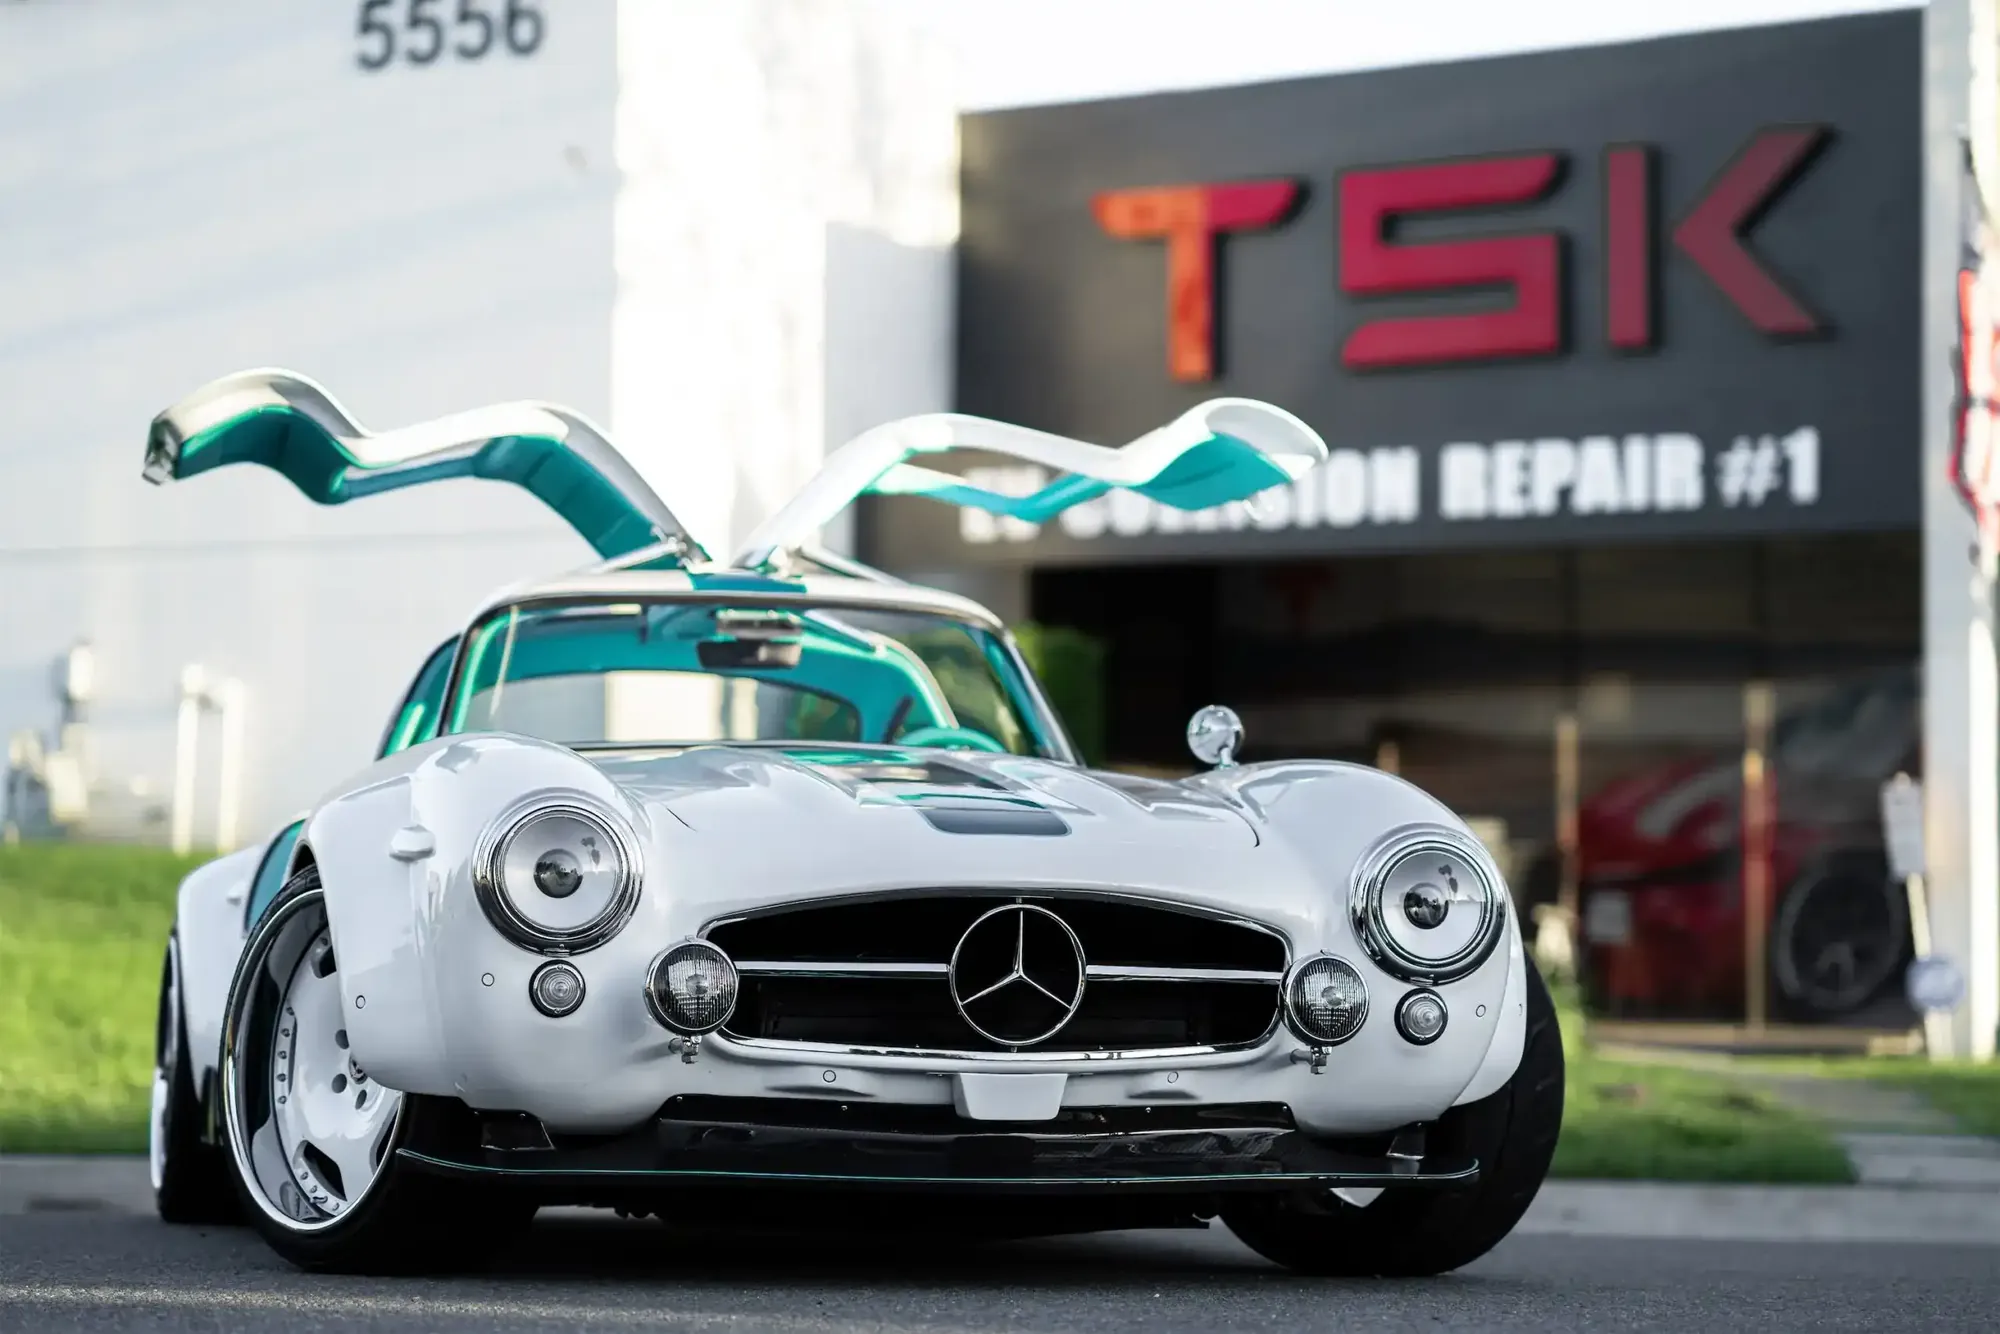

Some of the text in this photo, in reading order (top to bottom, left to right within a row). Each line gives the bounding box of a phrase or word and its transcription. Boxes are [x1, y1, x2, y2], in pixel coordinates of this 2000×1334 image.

[356, 0, 546, 71] 5556
[1092, 123, 1832, 382] TSK
[1439, 432, 1704, 520] REPAIR
[1715, 426, 1819, 506] #1
